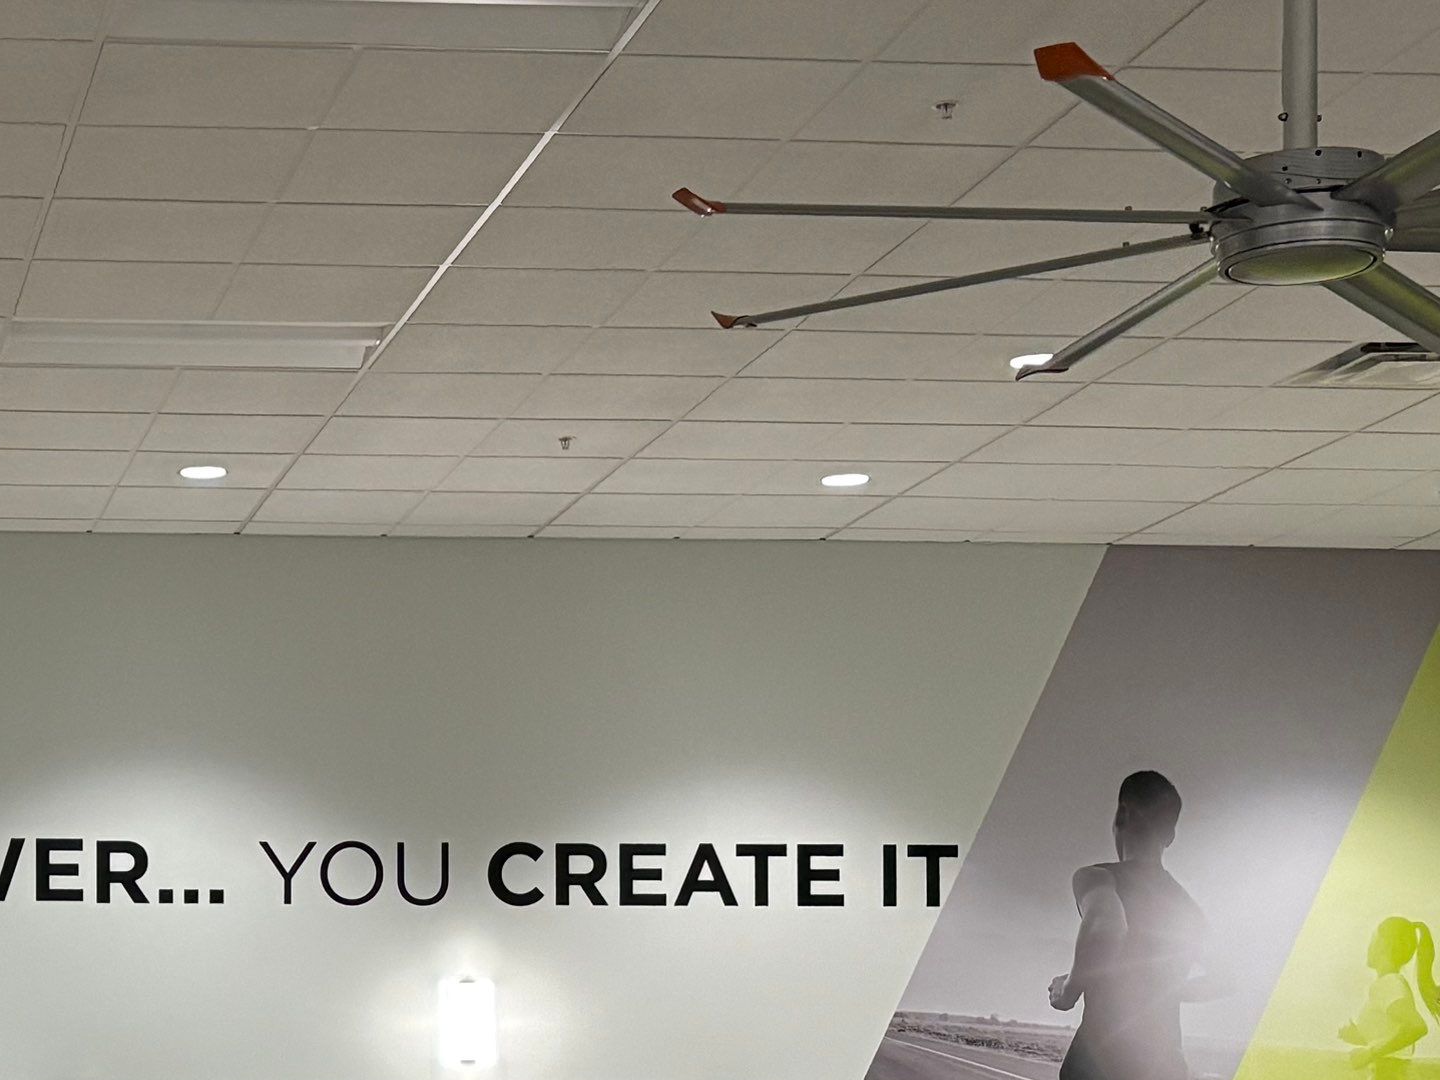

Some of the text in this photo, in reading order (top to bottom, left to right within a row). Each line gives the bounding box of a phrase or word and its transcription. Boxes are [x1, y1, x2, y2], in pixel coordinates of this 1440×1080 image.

[258, 840, 451, 907] YOU
[487, 841, 846, 907] CREATE
[882, 844, 959, 907] IT
